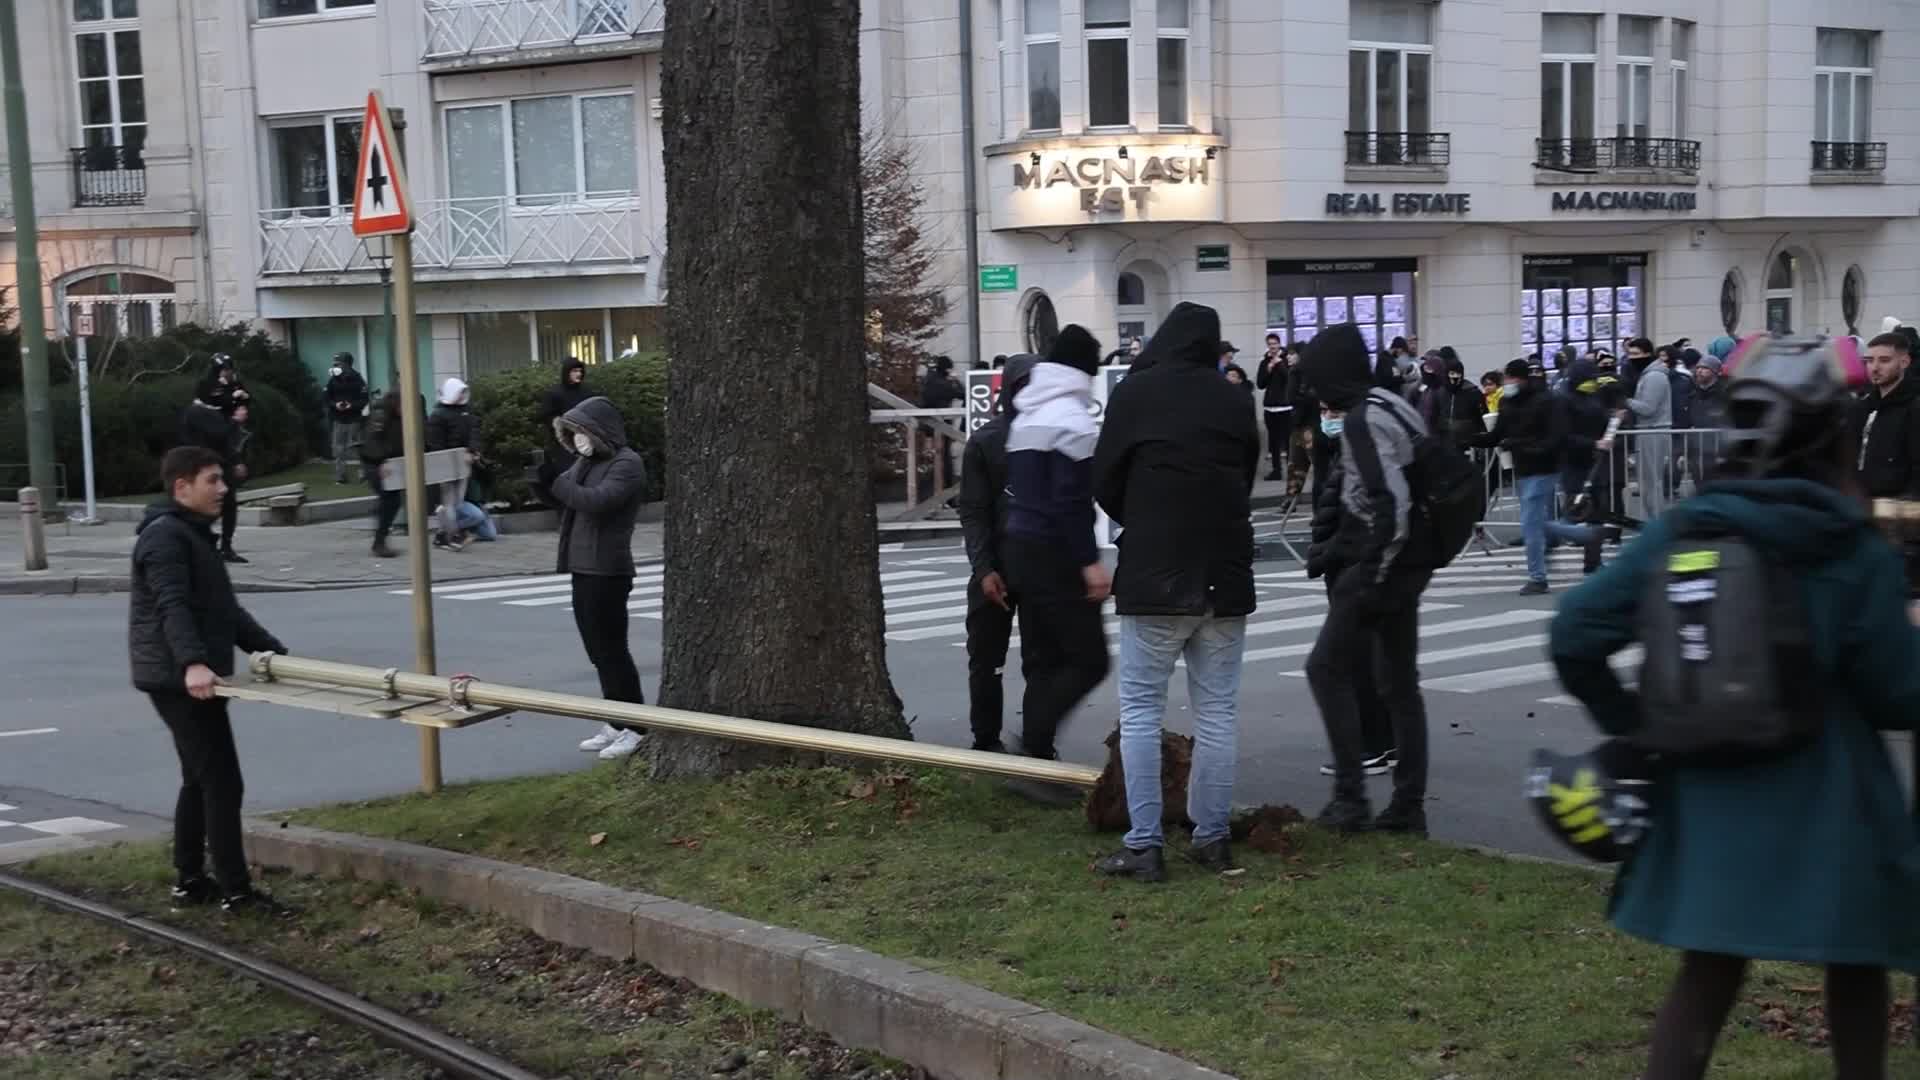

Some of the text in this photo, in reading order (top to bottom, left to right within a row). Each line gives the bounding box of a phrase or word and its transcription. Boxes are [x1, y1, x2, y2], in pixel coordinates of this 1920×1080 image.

[1013, 155, 1209, 190] MACNASH
[1080, 186, 1151, 213] EST
[1326, 193, 1471, 214] REAL ESTATE
